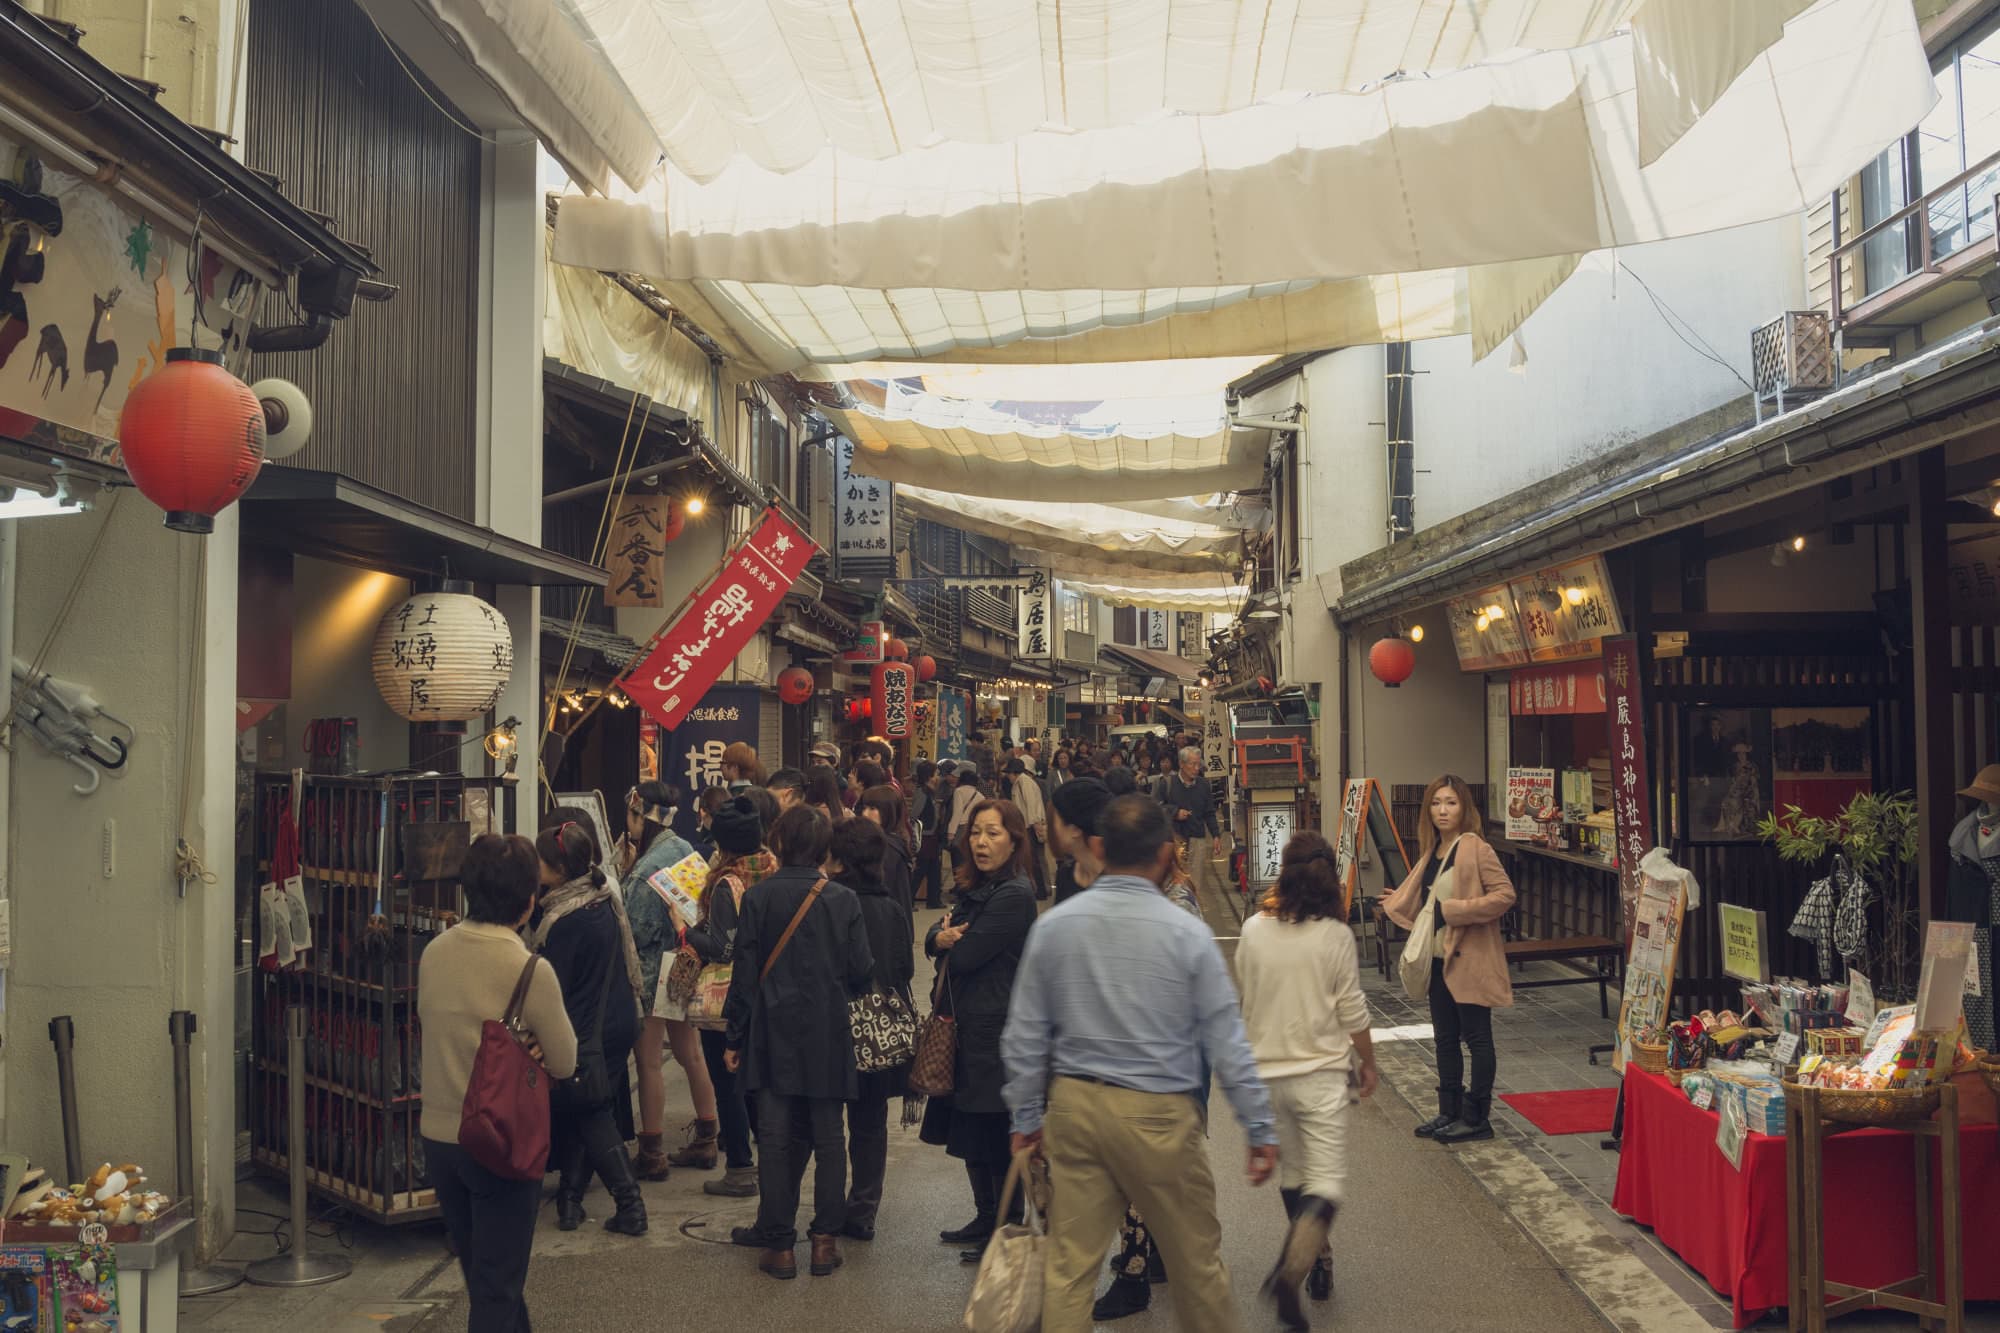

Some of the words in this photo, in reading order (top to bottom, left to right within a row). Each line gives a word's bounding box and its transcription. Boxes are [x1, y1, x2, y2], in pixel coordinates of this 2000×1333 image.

[847, 484, 880, 502] かき
[843, 505, 885, 527] あなご
[1023, 571, 1047, 655] 鳥居屋
[1613, 653, 1629, 690] 寿
[883, 669, 907, 737] 焼あなご
[684, 740, 729, 812] 揚
[851, 1012, 891, 1041] café
